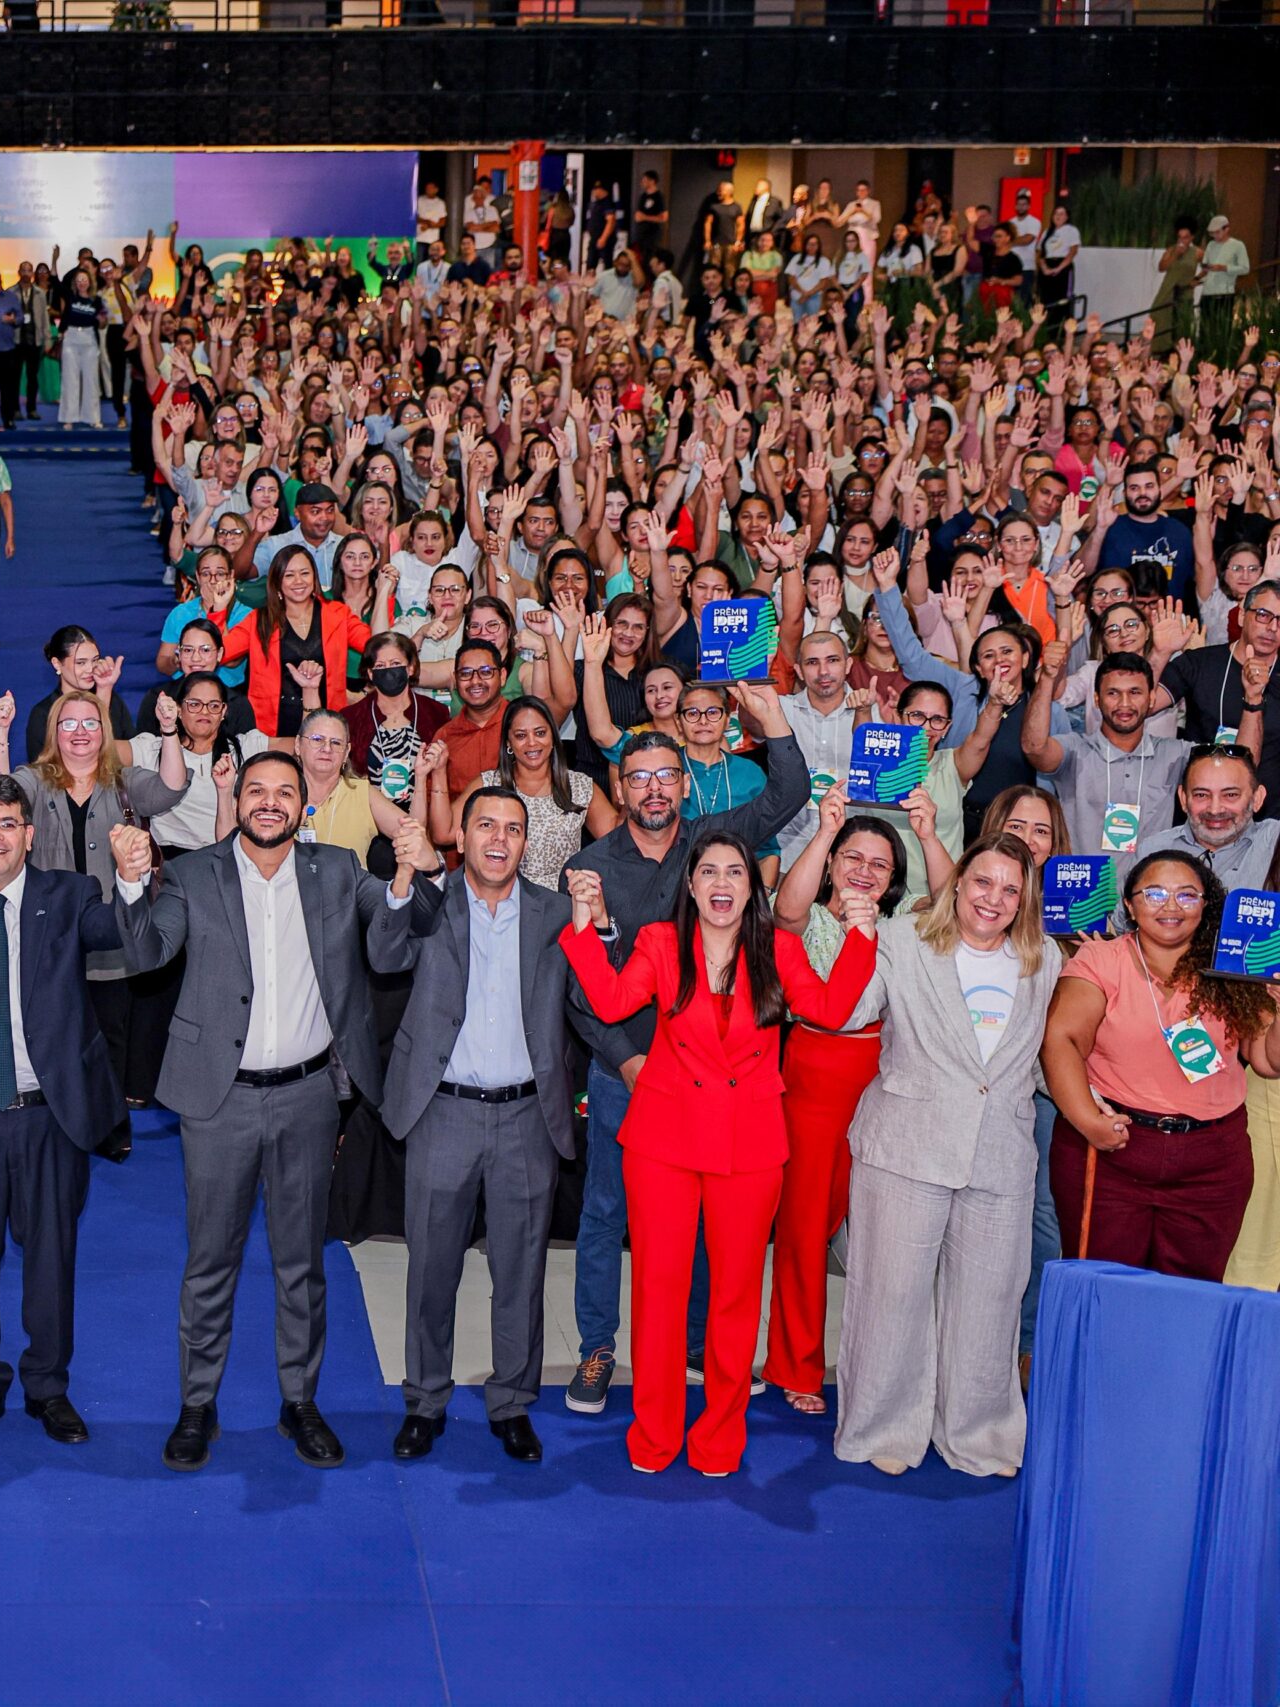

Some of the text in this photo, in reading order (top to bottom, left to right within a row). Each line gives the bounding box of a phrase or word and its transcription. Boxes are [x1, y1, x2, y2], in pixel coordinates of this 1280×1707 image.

[713, 606, 748, 616] PRÊMIO
[713, 615, 748, 626] IDEPI
[713, 625, 748, 634] 2024
[865, 729, 901, 740] PRÊMIO
[864, 737, 901, 750] IDEPI
[864, 747, 900, 757] 2024
[1057, 862, 1091, 871] PRÊMIO
[1056, 870, 1091, 881] IDEPI
[1056, 880, 1091, 888] 2024
[1239, 896, 1276, 908] PRÊMIO
[1237, 904, 1275, 919] IDEPI
[1236, 915, 1273, 927] 2024
